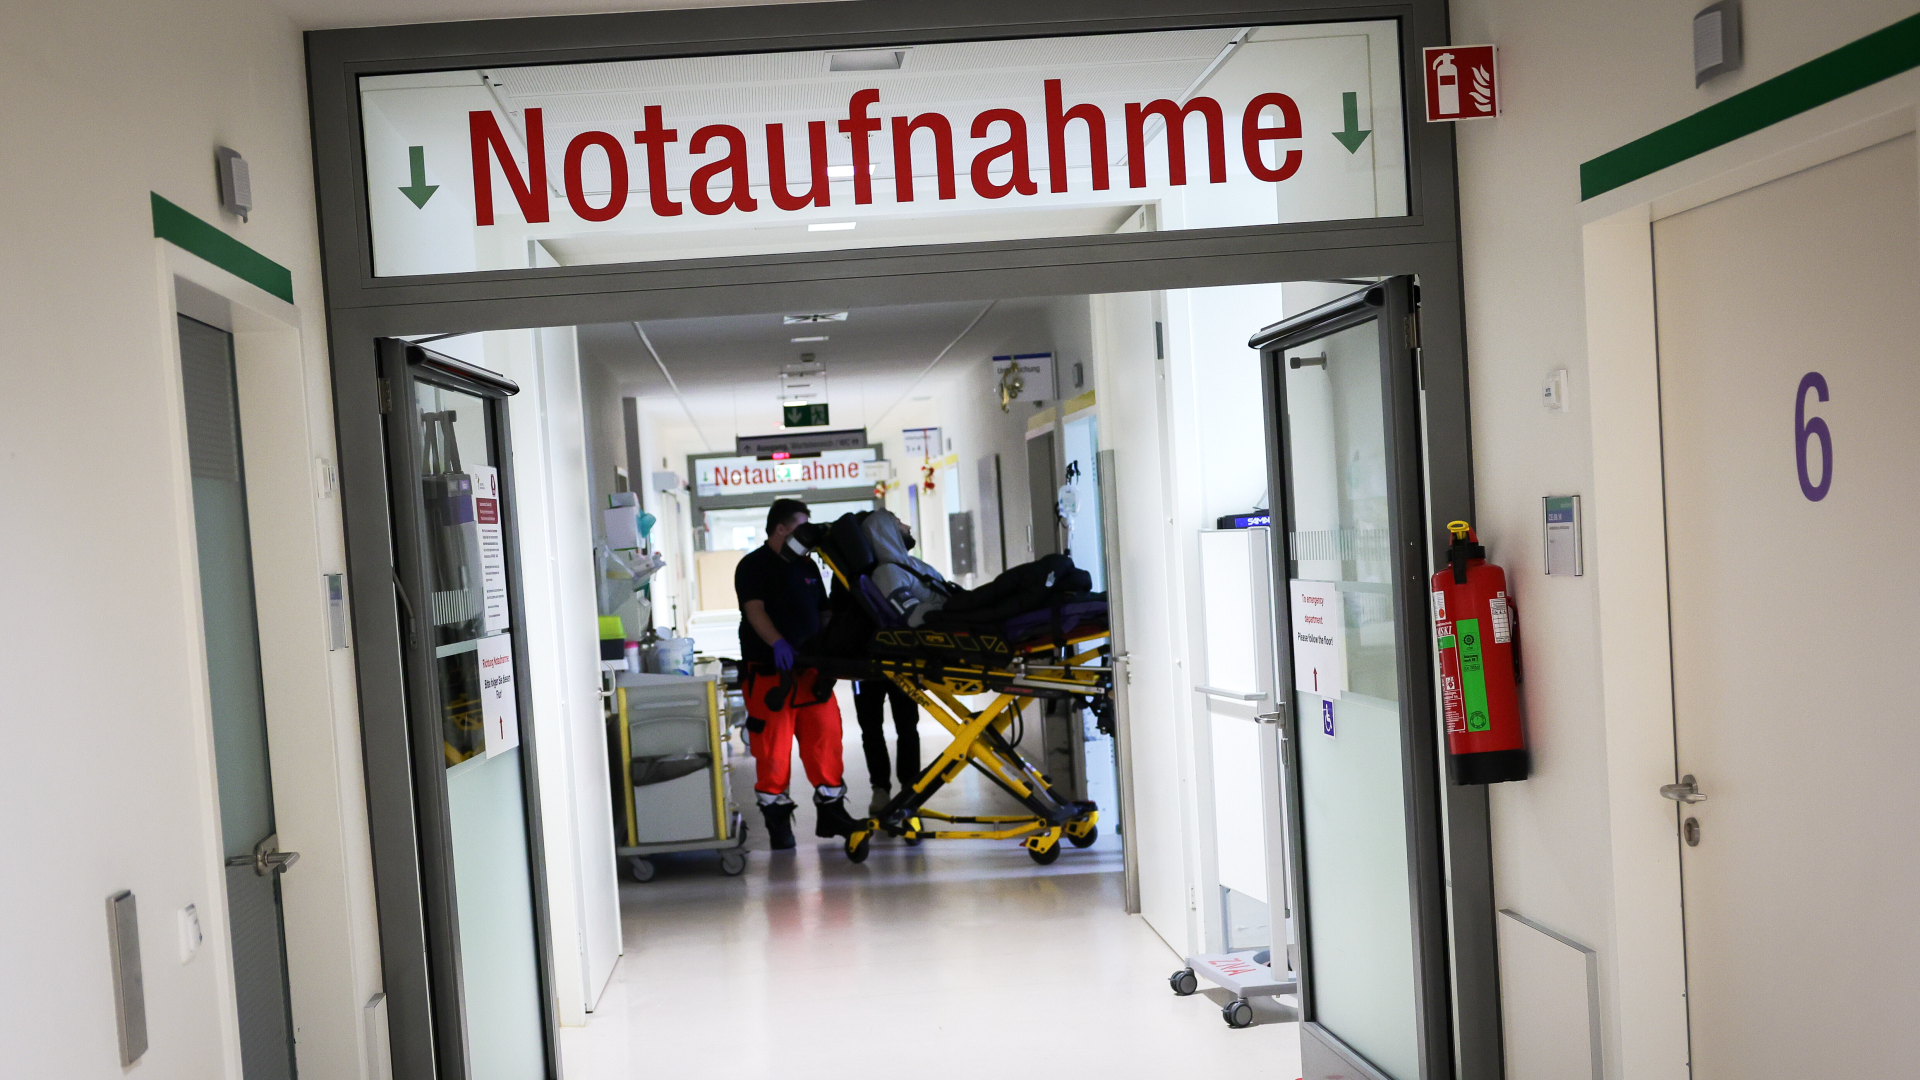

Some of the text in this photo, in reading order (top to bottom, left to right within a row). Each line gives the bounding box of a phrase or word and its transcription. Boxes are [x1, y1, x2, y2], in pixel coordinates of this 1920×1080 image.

[468, 79, 1304, 226] Notaufnahme
[1795, 372, 1833, 502] 6
[715, 461, 859, 487] Notauahme
[1307, 597, 1324, 606] emergency
[1298, 632, 1308, 642] Please
